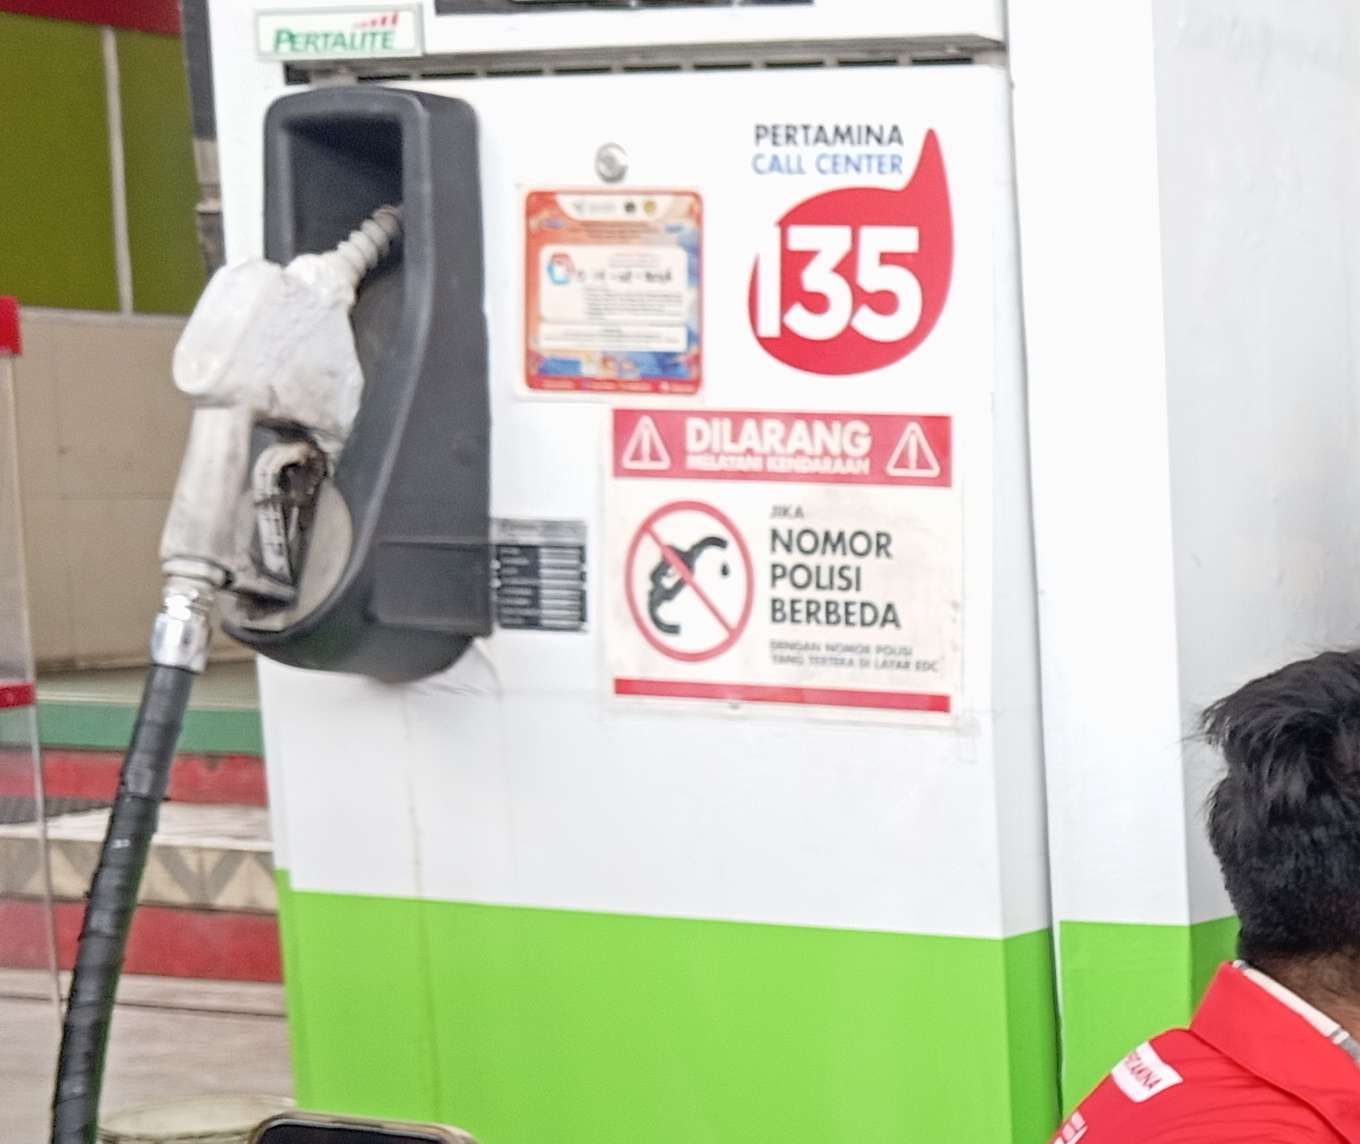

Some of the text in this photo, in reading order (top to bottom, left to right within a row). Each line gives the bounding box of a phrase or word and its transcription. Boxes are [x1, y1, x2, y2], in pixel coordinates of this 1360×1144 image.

[274, 27, 395, 52] PERTALITE
[755, 124, 904, 147] PERTAMINA
[752, 153, 903, 175] CALL CENTER
[756, 225, 924, 343] 135
[685, 417, 872, 456] DILARANG
[770, 505, 805, 519] JIKA
[770, 529, 893, 559] NOMOR
[770, 563, 862, 592] POLISI
[770, 598, 901, 629] BERBEDA
